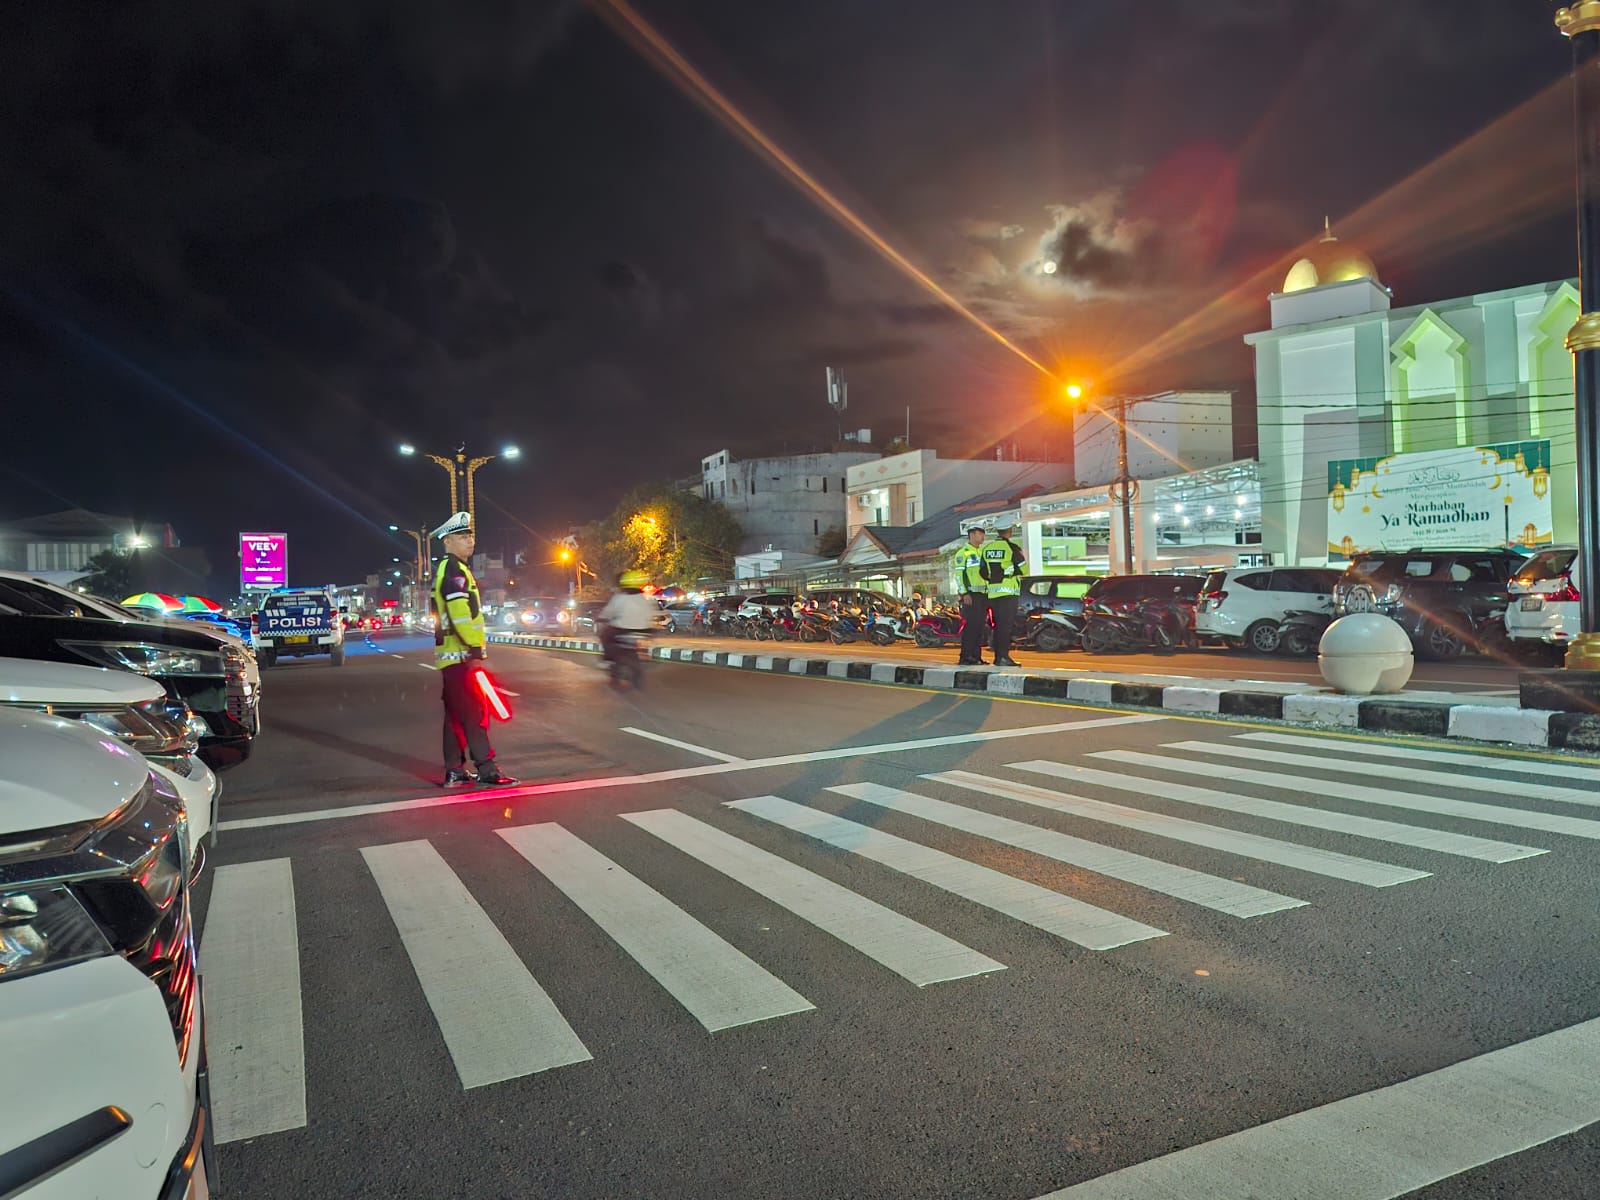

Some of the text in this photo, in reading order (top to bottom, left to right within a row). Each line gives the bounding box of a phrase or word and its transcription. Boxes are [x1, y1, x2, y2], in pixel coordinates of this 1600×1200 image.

[1405, 500, 1465, 512] Marhaban
[1380, 509, 1490, 530] Ya Ramadhan
[269, 617, 322, 628] POLISI
